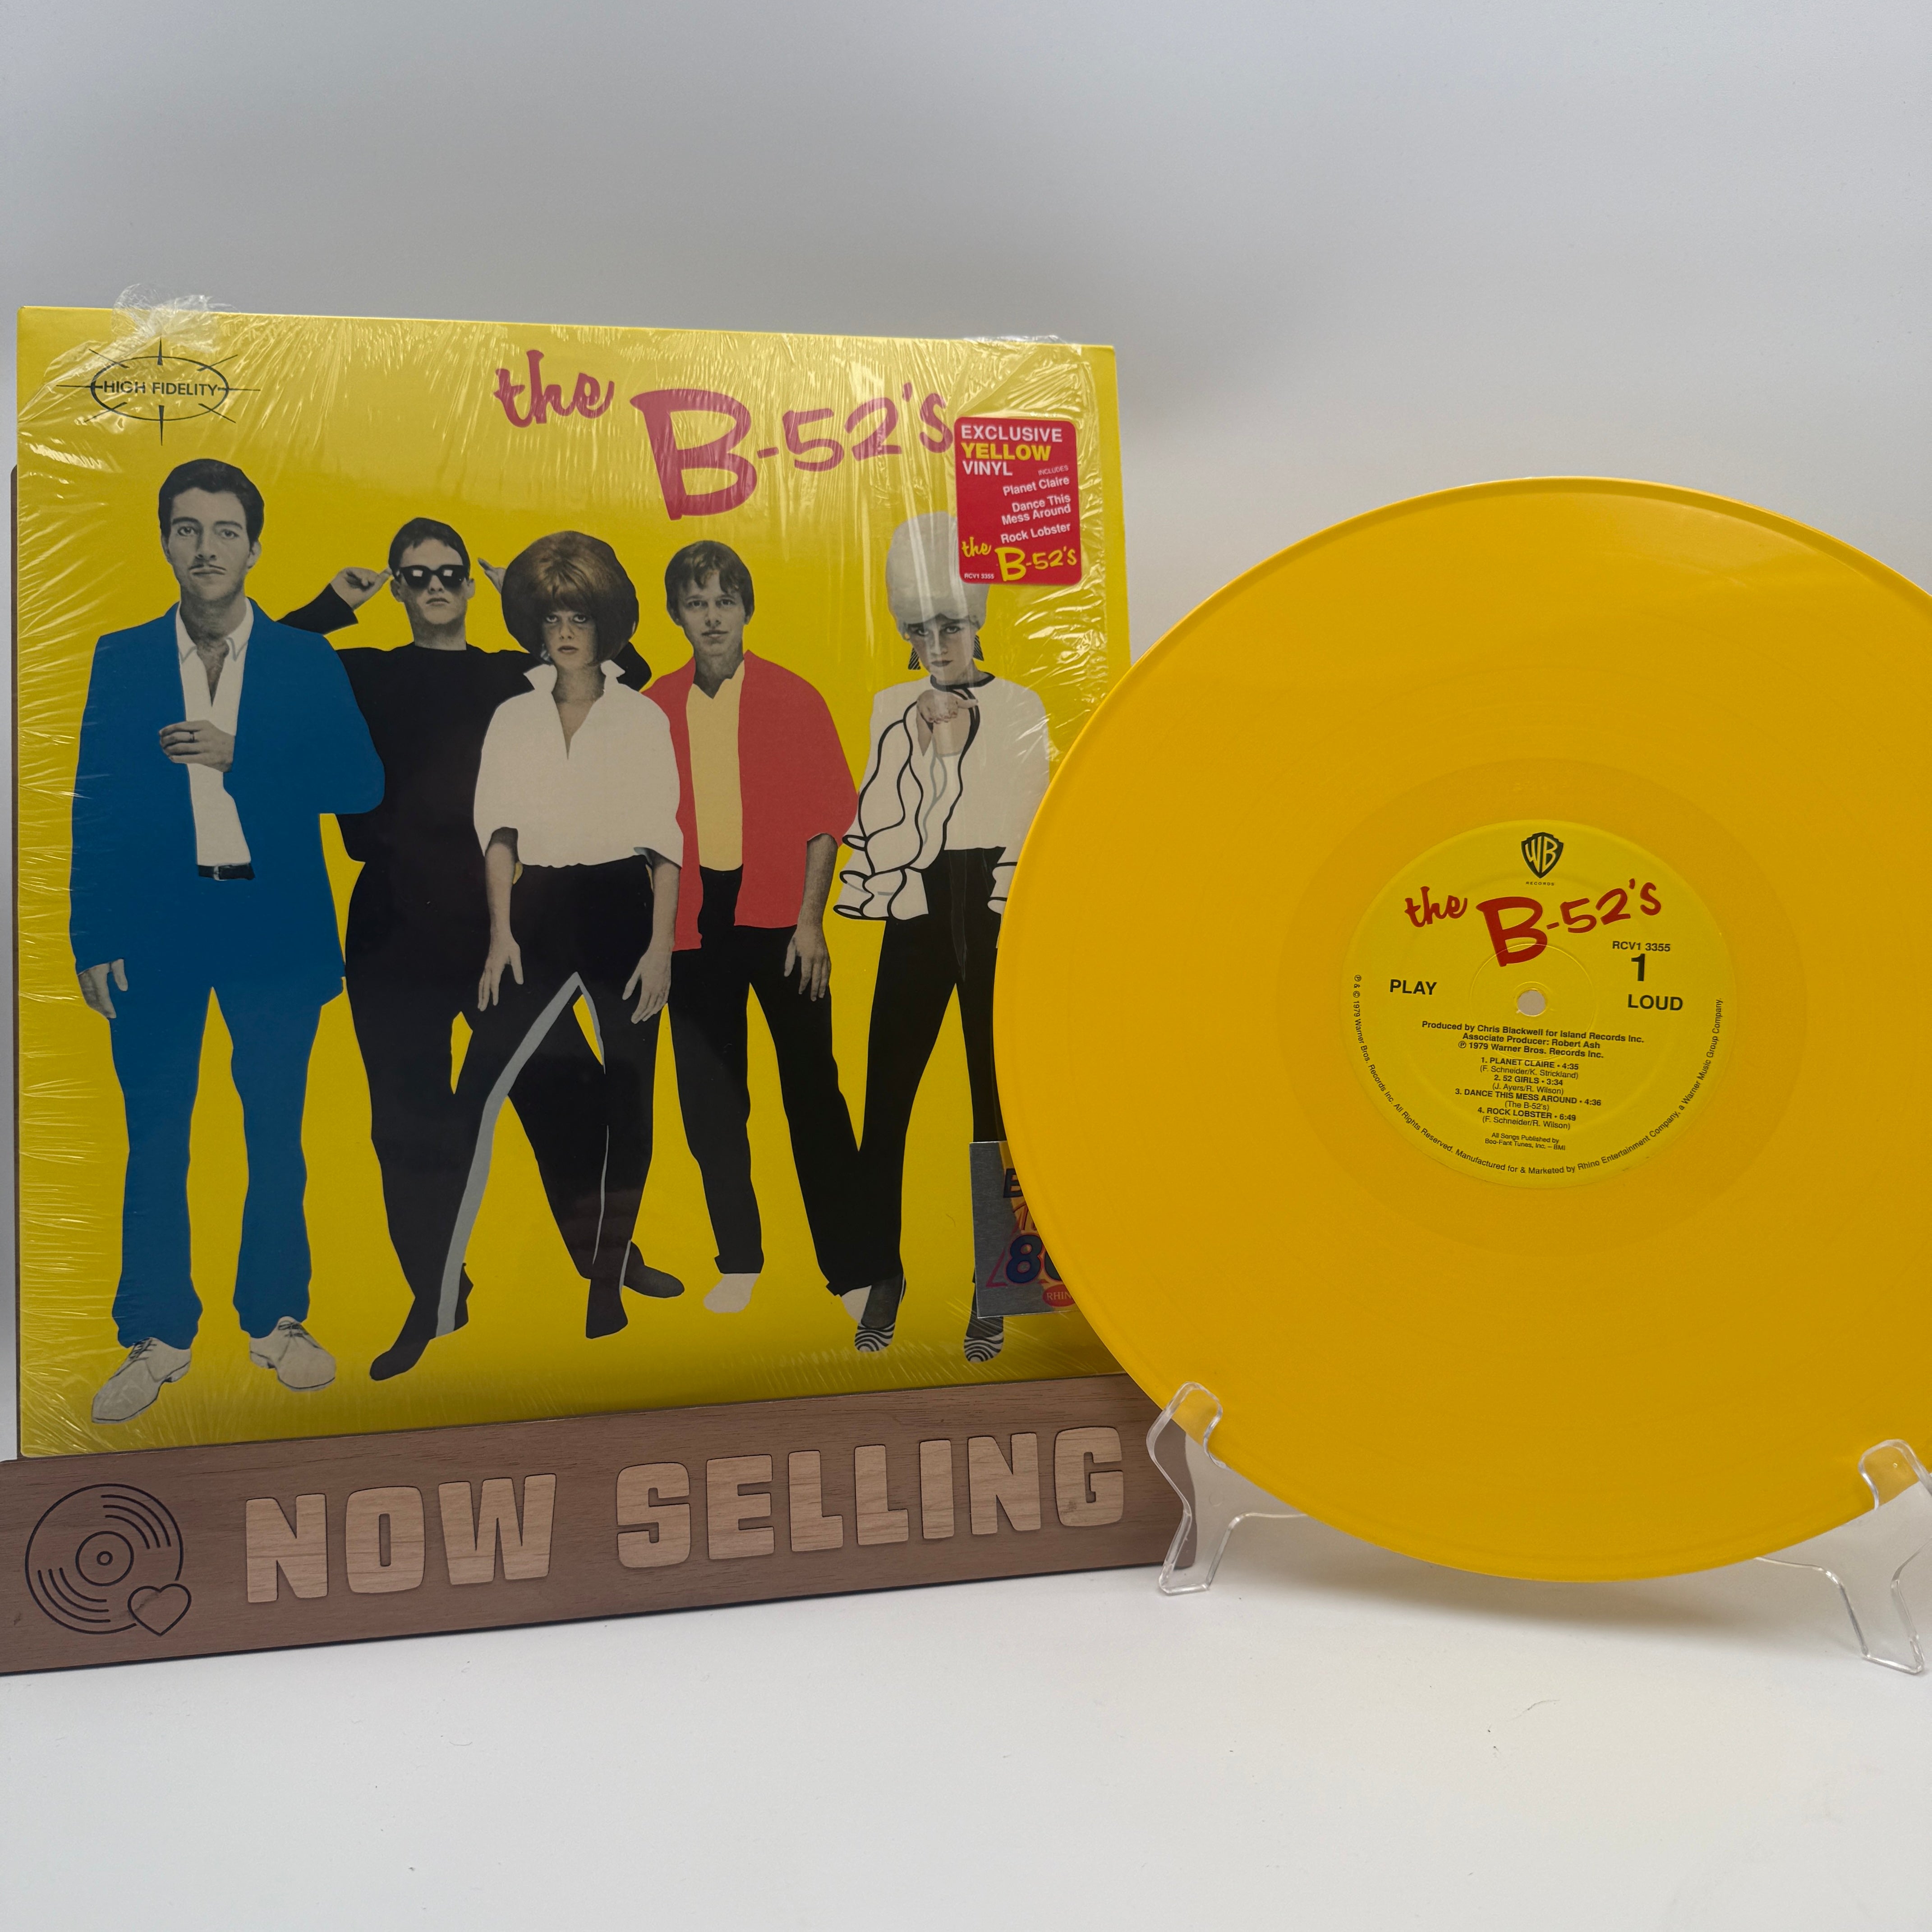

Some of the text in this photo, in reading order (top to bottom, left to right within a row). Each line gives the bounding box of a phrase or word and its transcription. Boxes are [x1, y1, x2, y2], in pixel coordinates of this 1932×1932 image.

[104, 380, 218, 396] HIGH FIDELITY
[493, 349, 954, 521] the B-52's
[961, 425, 1063, 442] EXCLUSIVE
[961, 442, 1052, 461] YELLOW
[962, 460, 1013, 476] VINYL
[1038, 465, 1069, 476] INCLUDES
[1003, 476, 1070, 496] Planet Claire
[1012, 494, 1071, 513] Dance This
[1001, 504, 1071, 525] Mess Around
[1000, 524, 1071, 544] Rock Lobster
[961, 537, 1077, 582] the B-52's
[1524, 836, 1558, 873] WB
[1404, 878, 1662, 967] the B-52's
[1613, 941, 1671, 952] RCV1 3355
[1631, 953, 1647, 982] 1
[1389, 979, 1437, 995] PLAY
[1628, 994, 1683, 1011] LOUD
[1712, 998, 1723, 1034] Company.
[1355, 1019, 1364, 1044] Warner
[1422, 1021, 1462, 1030] Produced
[1465, 1024, 1475, 1032] by
[1477, 1025, 1500, 1033] Chris
[1503, 1026, 1543, 1036] Blackwell
[1560, 1030, 1587, 1039] Island
[1589, 1032, 1626, 1042] Records
[1463, 1033, 1504, 1042] Associate
[1507, 1035, 1549, 1045] Producer:
[1552, 1039, 1581, 1048] Robert
[1361, 1045, 1370, 1063] Bros.
[1491, 1044, 1521, 1052] Warner
[1524, 1046, 1546, 1054] Bros.
[1549, 1048, 1585, 1057] Records
[1706, 1036, 1719, 1058] Group
[1490, 1057, 1522, 1066] PLANET
[1524, 1060, 1555, 1068] CLAIRE
[1697, 1059, 1711, 1080] Music
[1368, 1064, 1386, 1091] Records
[1480, 1065, 1578, 1080] (F. Schneider/K. Strickland)
[1384, 1091, 1394, 1104] Inc.
[1464, 1089, 1493, 1097] DANCE
[1541, 1095, 1577, 1104] AROUND
[1492, 1082, 1564, 1095] (J. Ayers/R. Wilson)
[1681, 1081, 1701, 1104] Warner
[1394, 1104, 1404, 1113] All
[1513, 1109, 1552, 1118] LOBSTER
[1524, 1102, 1549, 1111] B-52's)
[1402, 1111, 1421, 1130] Rights
[1493, 1117, 1540, 1126] Schneider/R.
[1543, 1120, 1570, 1130] Wilson)
[1649, 1111, 1681, 1137] Company,
[1421, 1128, 1453, 1153] Reserved.
[1521, 1135, 1550, 1143] Published
[1455, 1149, 1505, 1170] Manufactured
[1601, 1136, 1651, 1164] Entertainment
[1578, 1159, 1600, 1170] Rhino
[1046, 1292, 1072, 1300] RHIN
[246, 1426, 1125, 1603] NOW SELLING
